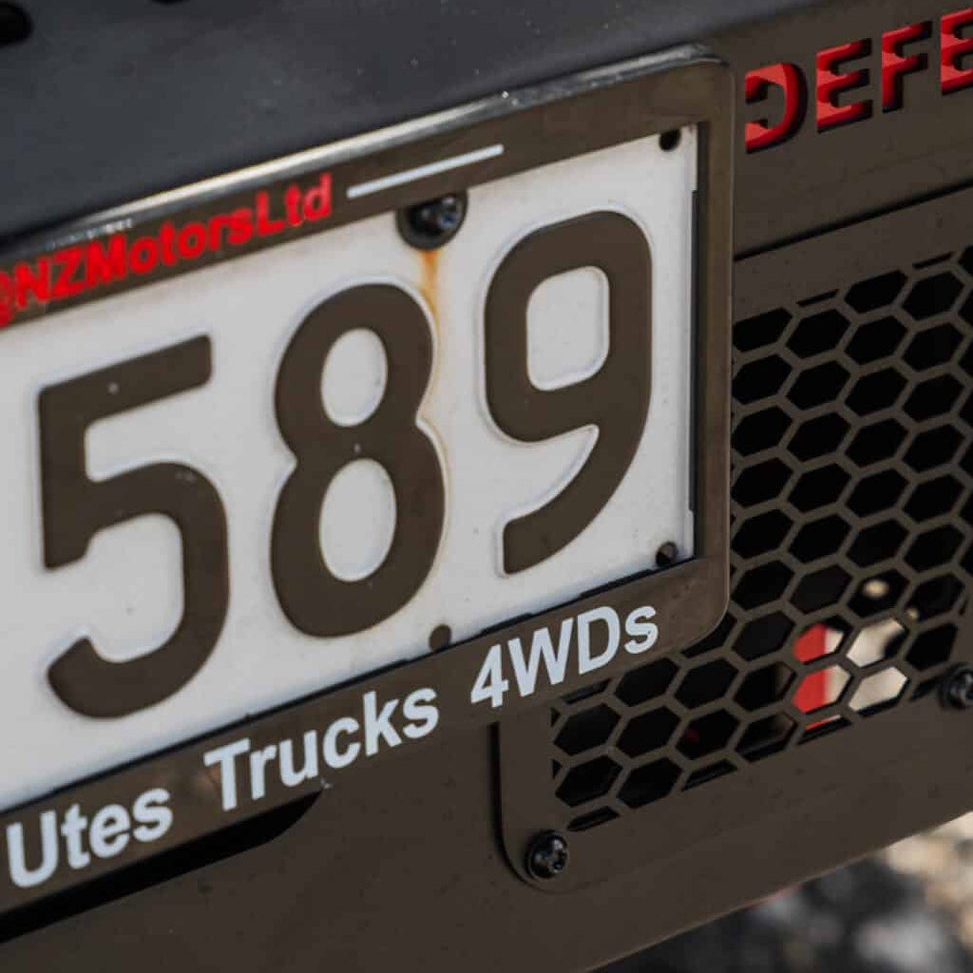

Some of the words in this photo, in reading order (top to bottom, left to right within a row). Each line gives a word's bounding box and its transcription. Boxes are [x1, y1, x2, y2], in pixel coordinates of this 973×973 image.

[36, 209, 653, 720] 589
[5, 787, 174, 888] Utes
[204, 688, 440, 811] Trucks
[470, 605, 659, 708] 4WDs
